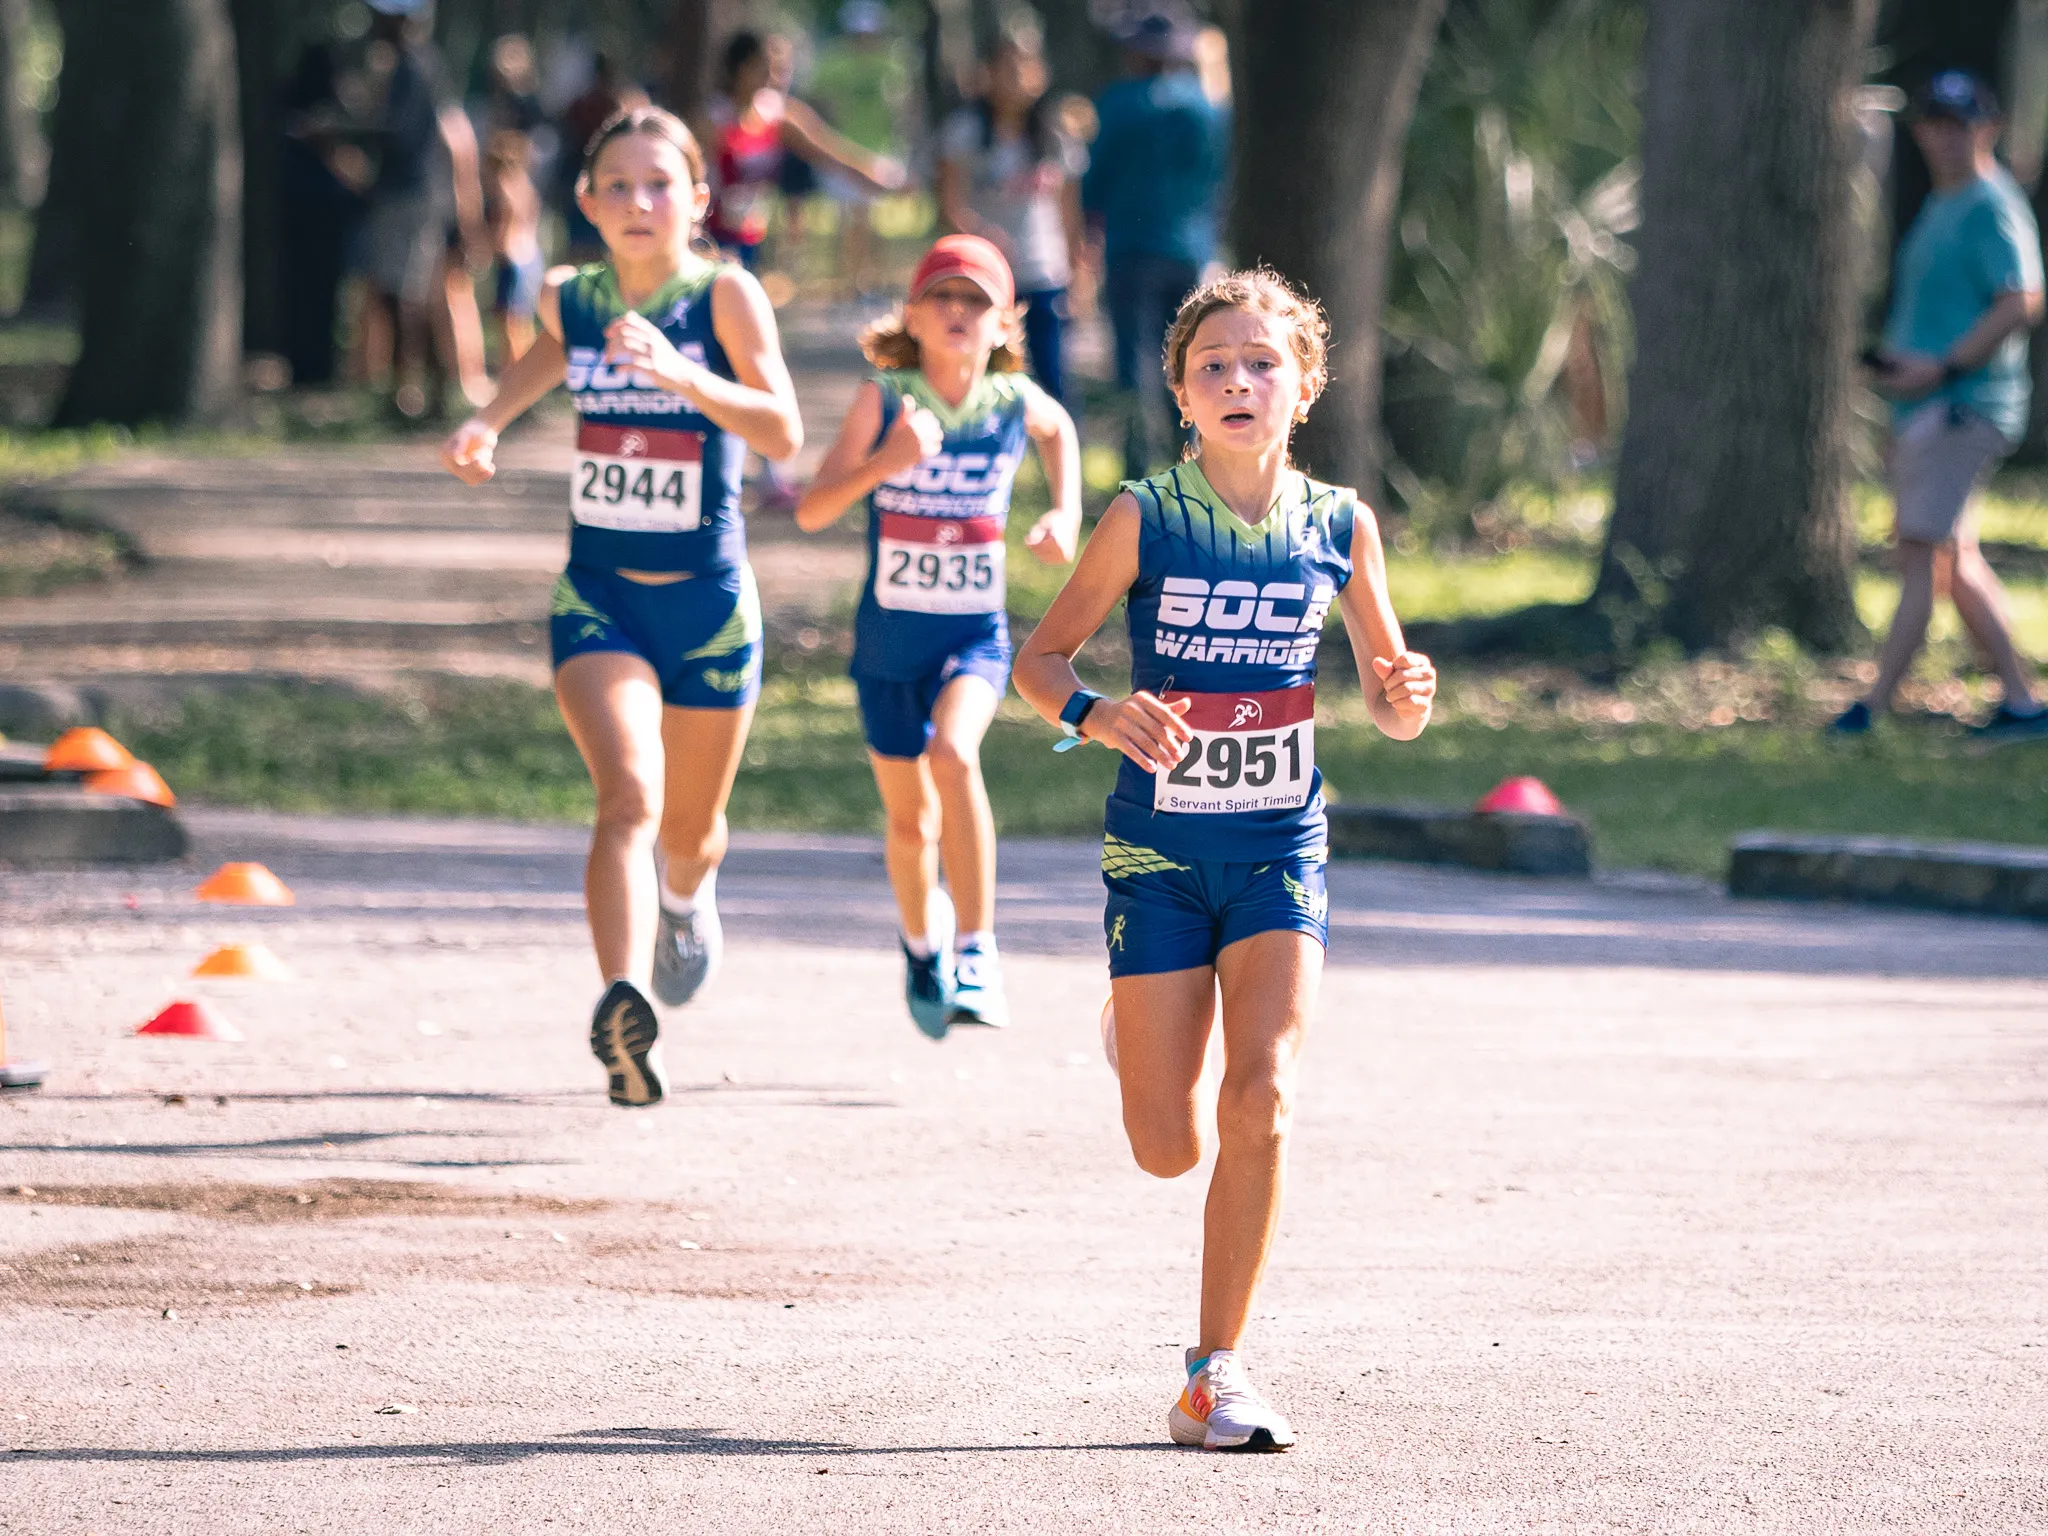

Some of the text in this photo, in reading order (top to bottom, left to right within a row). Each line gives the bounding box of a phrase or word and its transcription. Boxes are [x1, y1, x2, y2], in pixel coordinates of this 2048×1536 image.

[581, 461, 686, 508] 2944
[889, 550, 993, 591] 2935
[1167, 728, 1302, 789] 2951
[1170, 794, 1302, 813] Servant Spirit Timing
